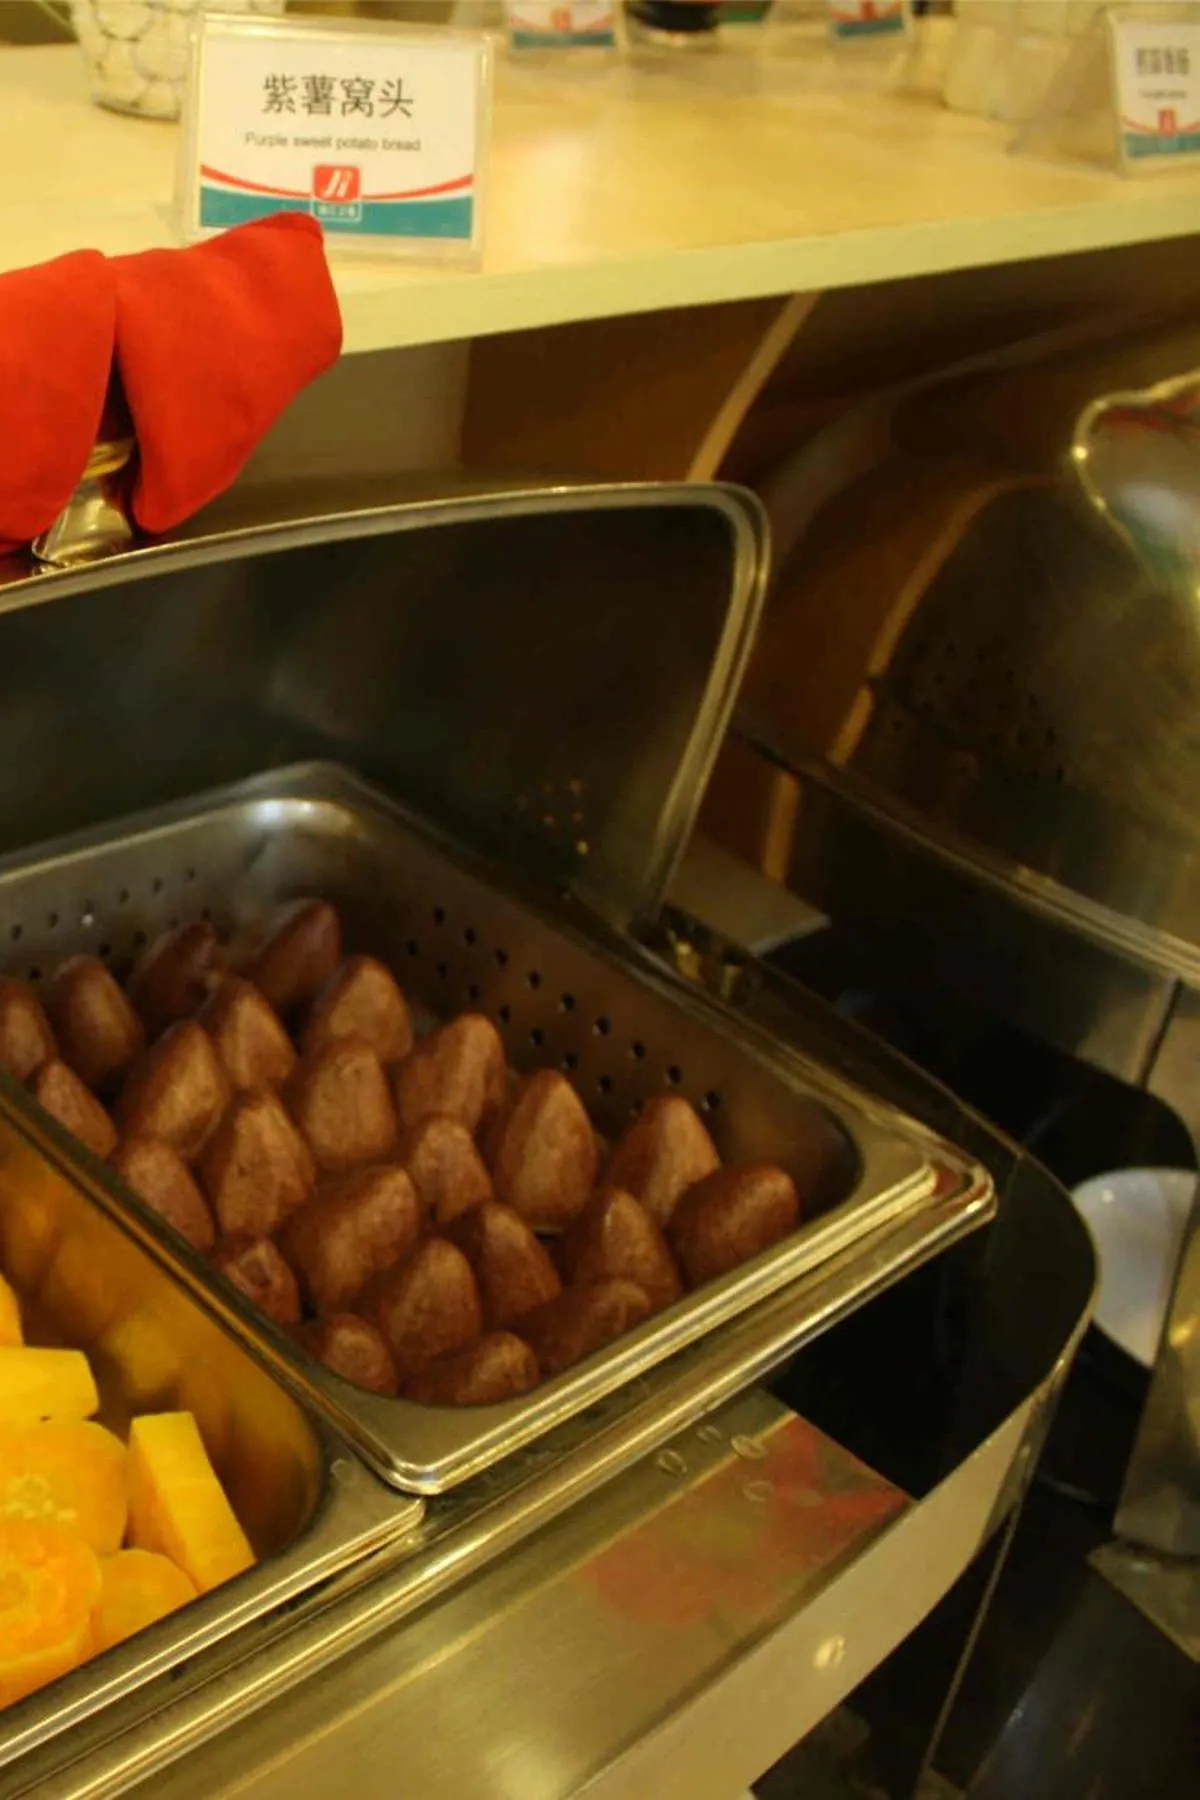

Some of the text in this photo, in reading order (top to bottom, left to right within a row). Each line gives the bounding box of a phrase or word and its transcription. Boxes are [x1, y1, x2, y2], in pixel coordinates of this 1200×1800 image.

[262, 73, 415, 118] 紫薯窝头
[245, 131, 422, 151] Purple sweet potato bread
